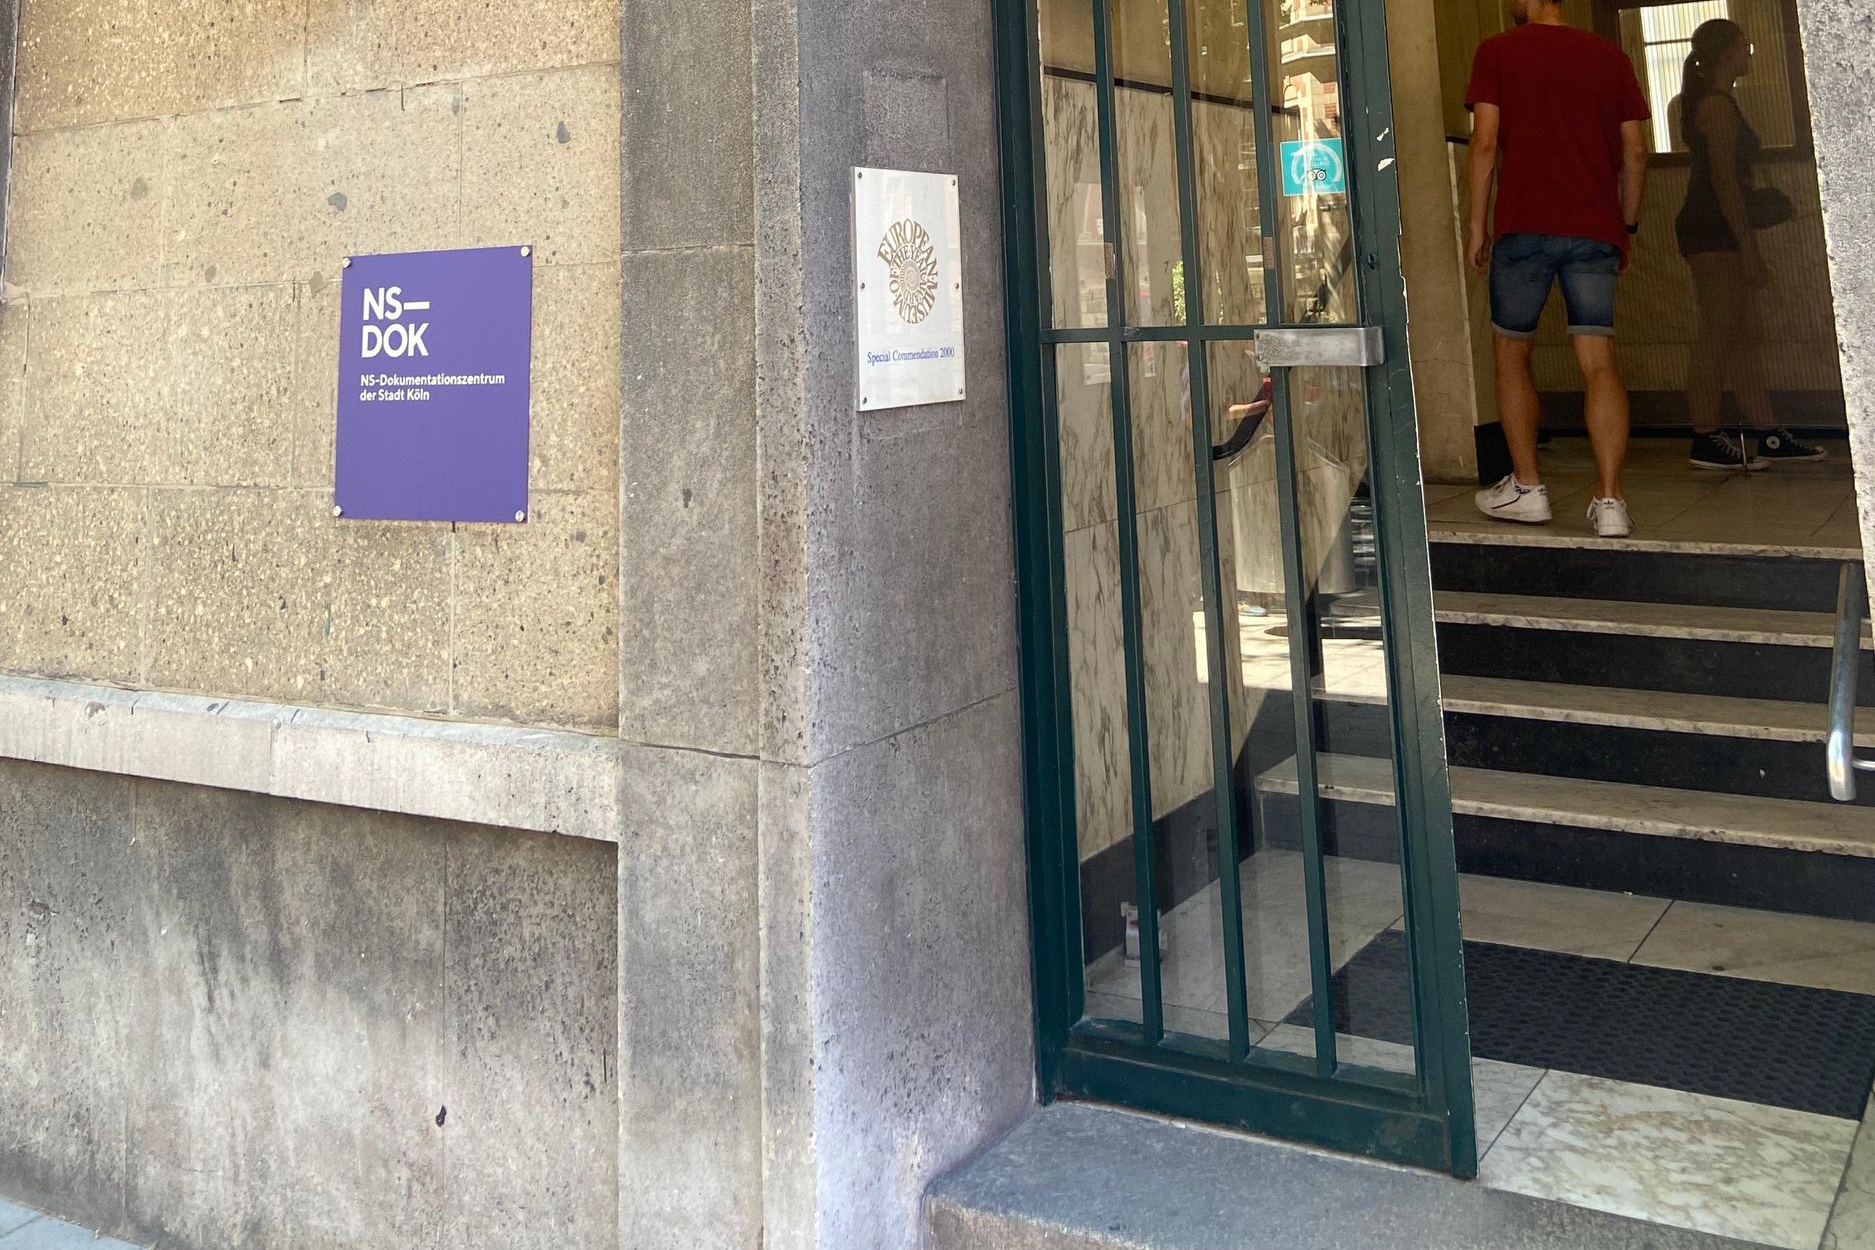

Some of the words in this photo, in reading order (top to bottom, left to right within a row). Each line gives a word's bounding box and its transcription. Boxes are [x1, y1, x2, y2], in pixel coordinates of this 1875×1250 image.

[877, 218, 938, 277] EUROPEAN
[893, 279, 938, 324] MUSEUM
[361, 322, 430, 358] DOK
[867, 351, 891, 365] Special
[892, 348, 939, 361] Commendation
[939, 347, 955, 358] 2000
[360, 373, 505, 387] NS-Dokumentationszentrum
[359, 389, 379, 401] der
[378, 388, 405, 401] Stadt
[406, 388, 430, 401] Köln
